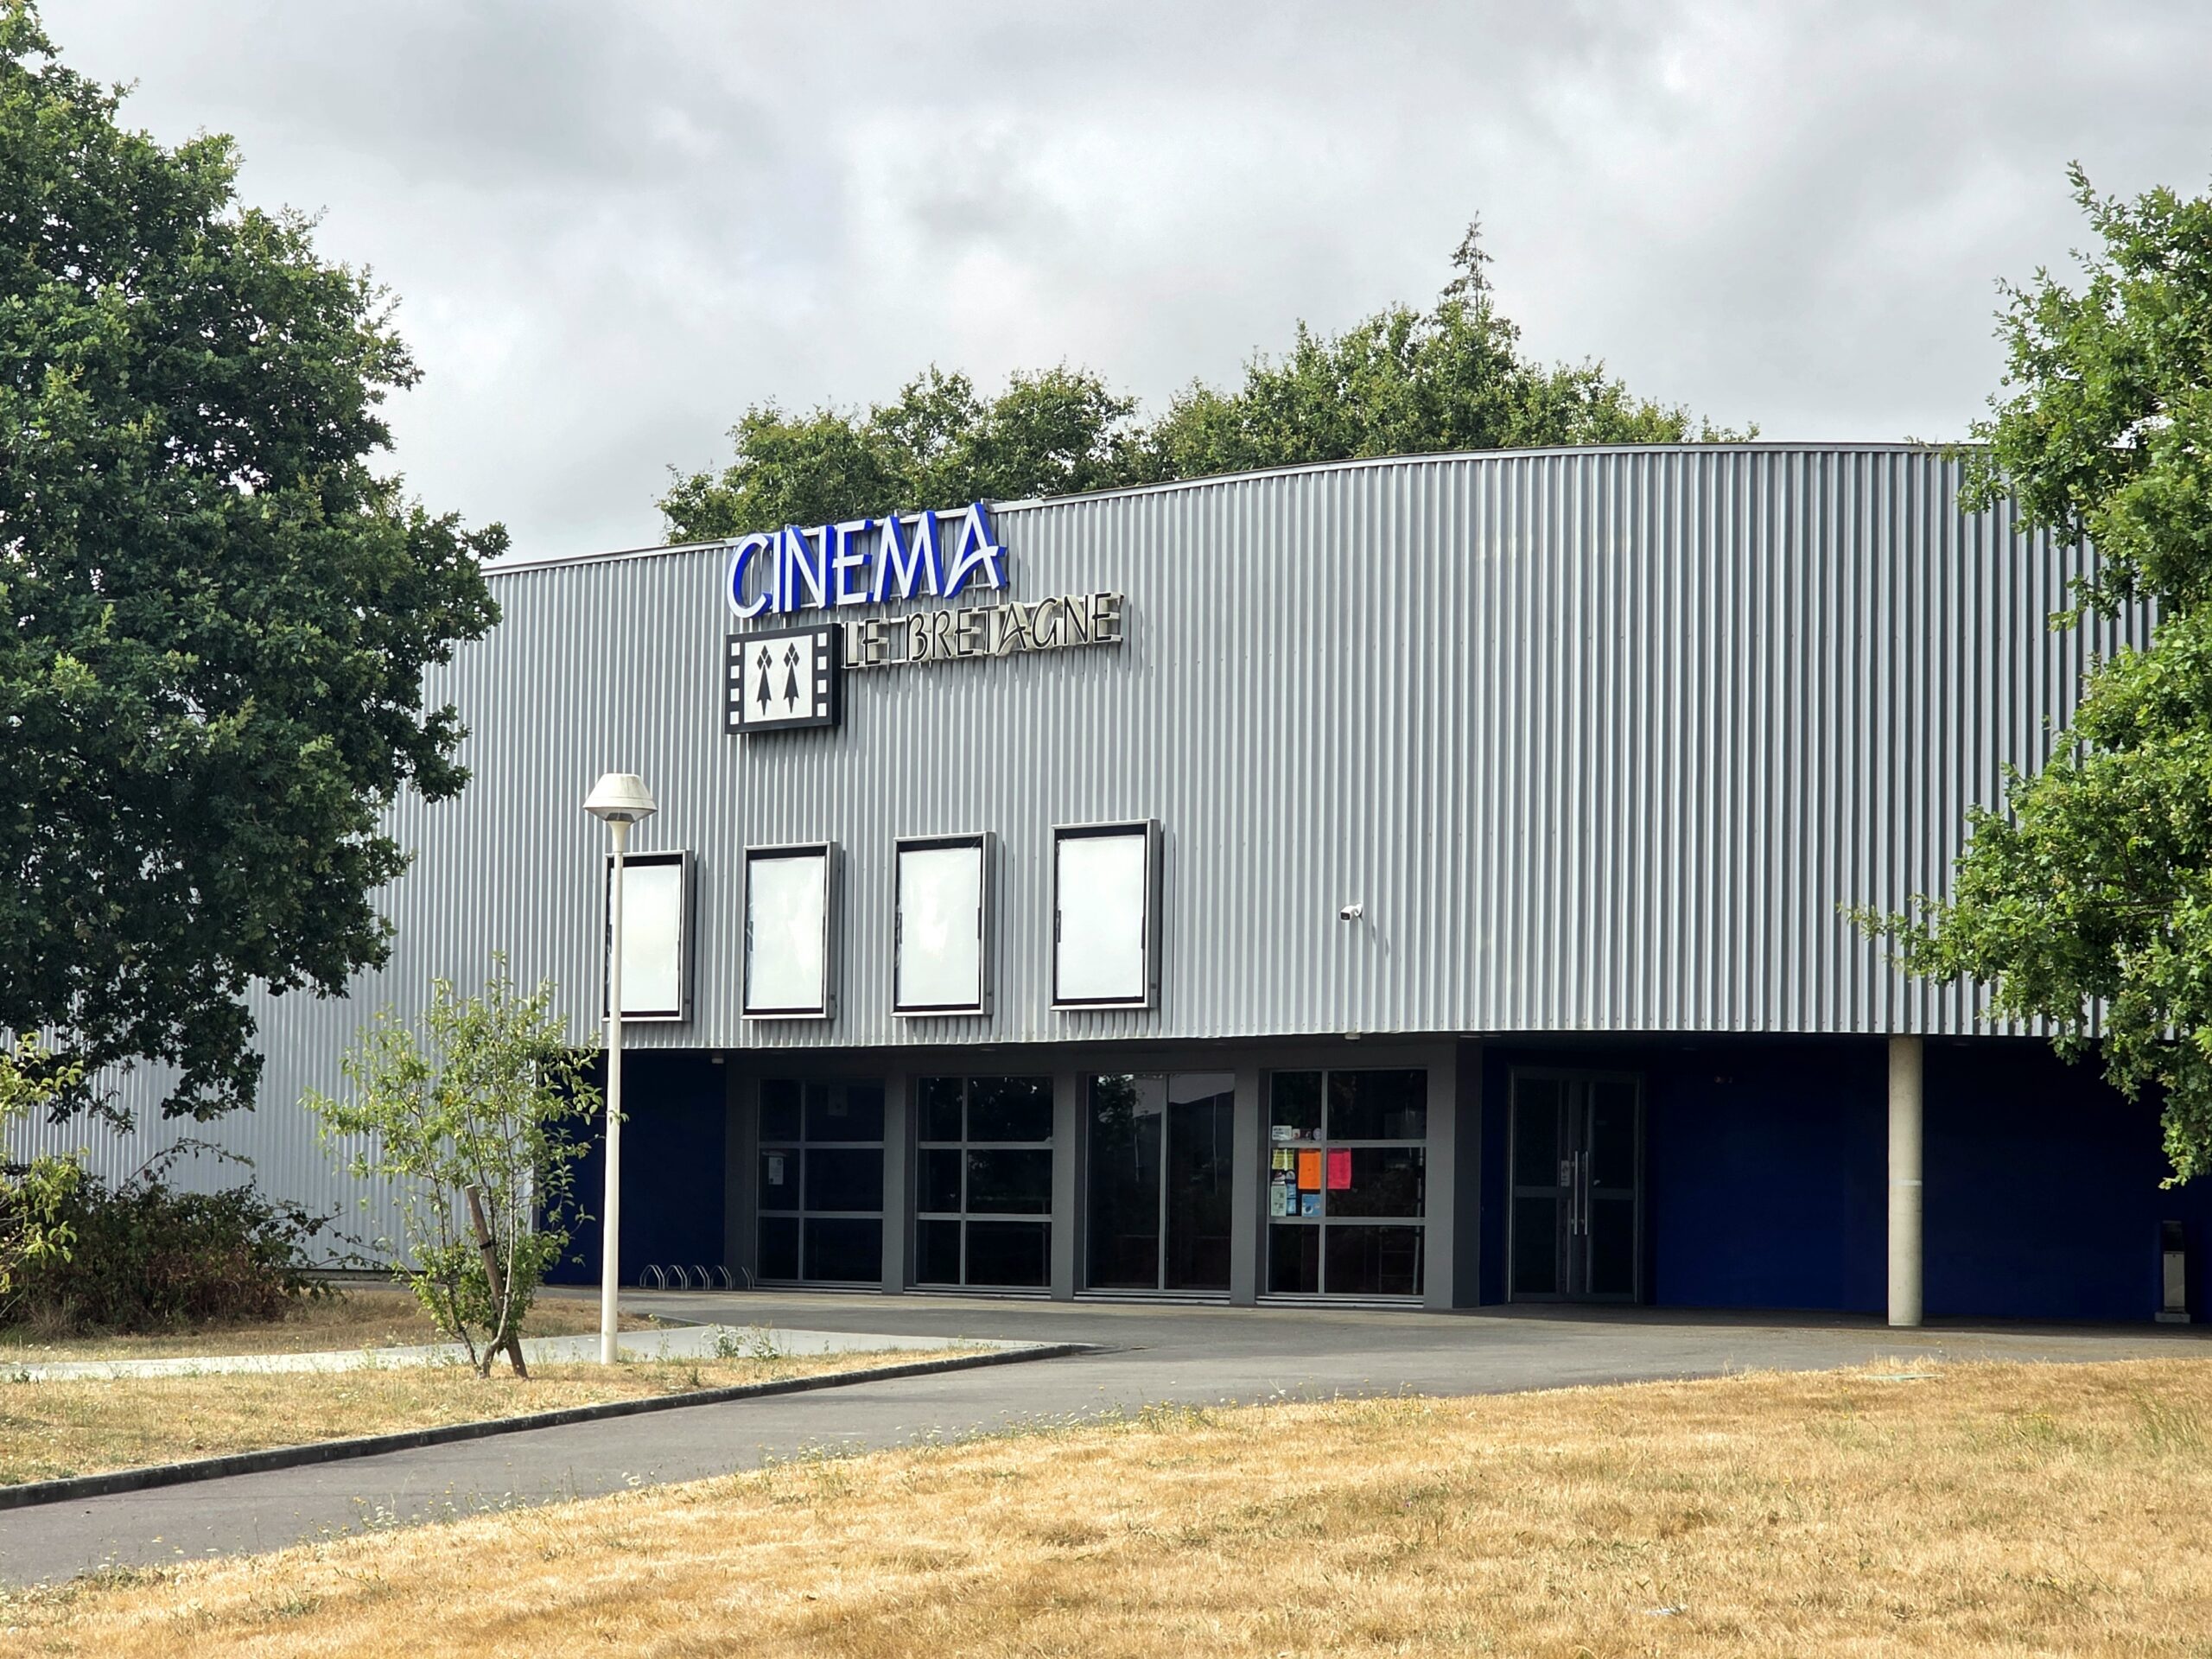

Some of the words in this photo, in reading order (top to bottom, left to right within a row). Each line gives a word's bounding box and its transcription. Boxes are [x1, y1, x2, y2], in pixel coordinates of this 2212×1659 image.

[727, 503, 1006, 618] CINEMA
[843, 618, 889, 669] LE
[905, 592, 1122, 662] BRETAGNE
